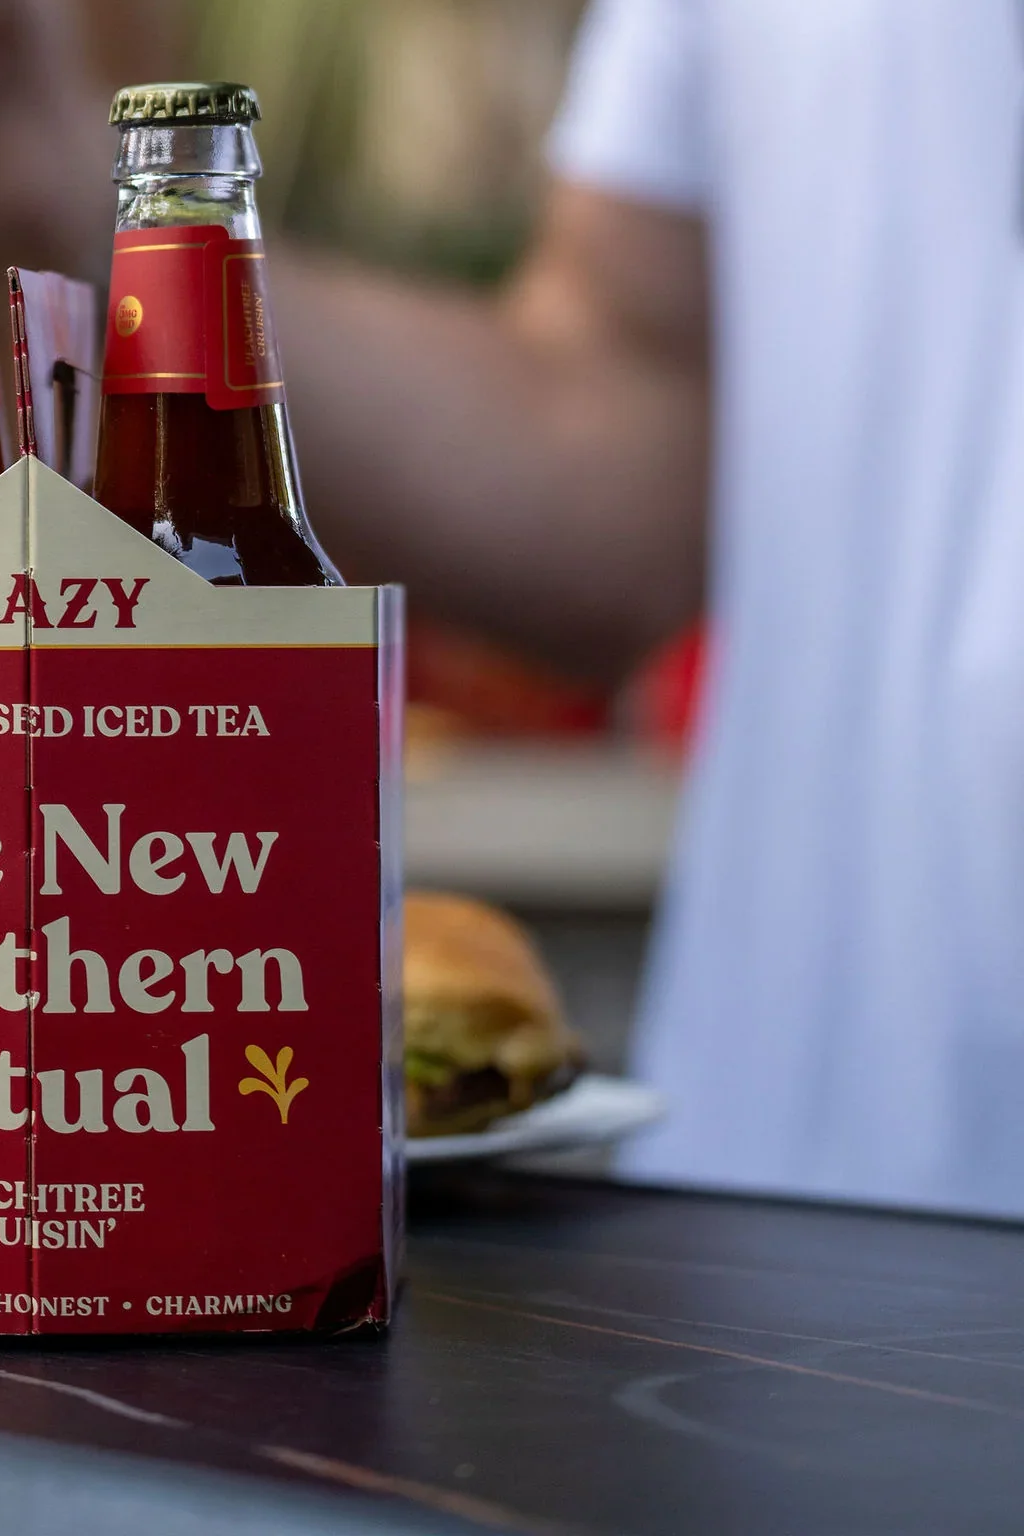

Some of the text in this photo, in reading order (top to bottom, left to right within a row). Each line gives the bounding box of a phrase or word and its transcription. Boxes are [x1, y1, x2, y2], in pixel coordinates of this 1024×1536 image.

[83, 706, 180, 737] ICED
[189, 706, 270, 736] TEA
[39, 804, 279, 895] New
[146, 1295, 292, 1315] CHARMING
